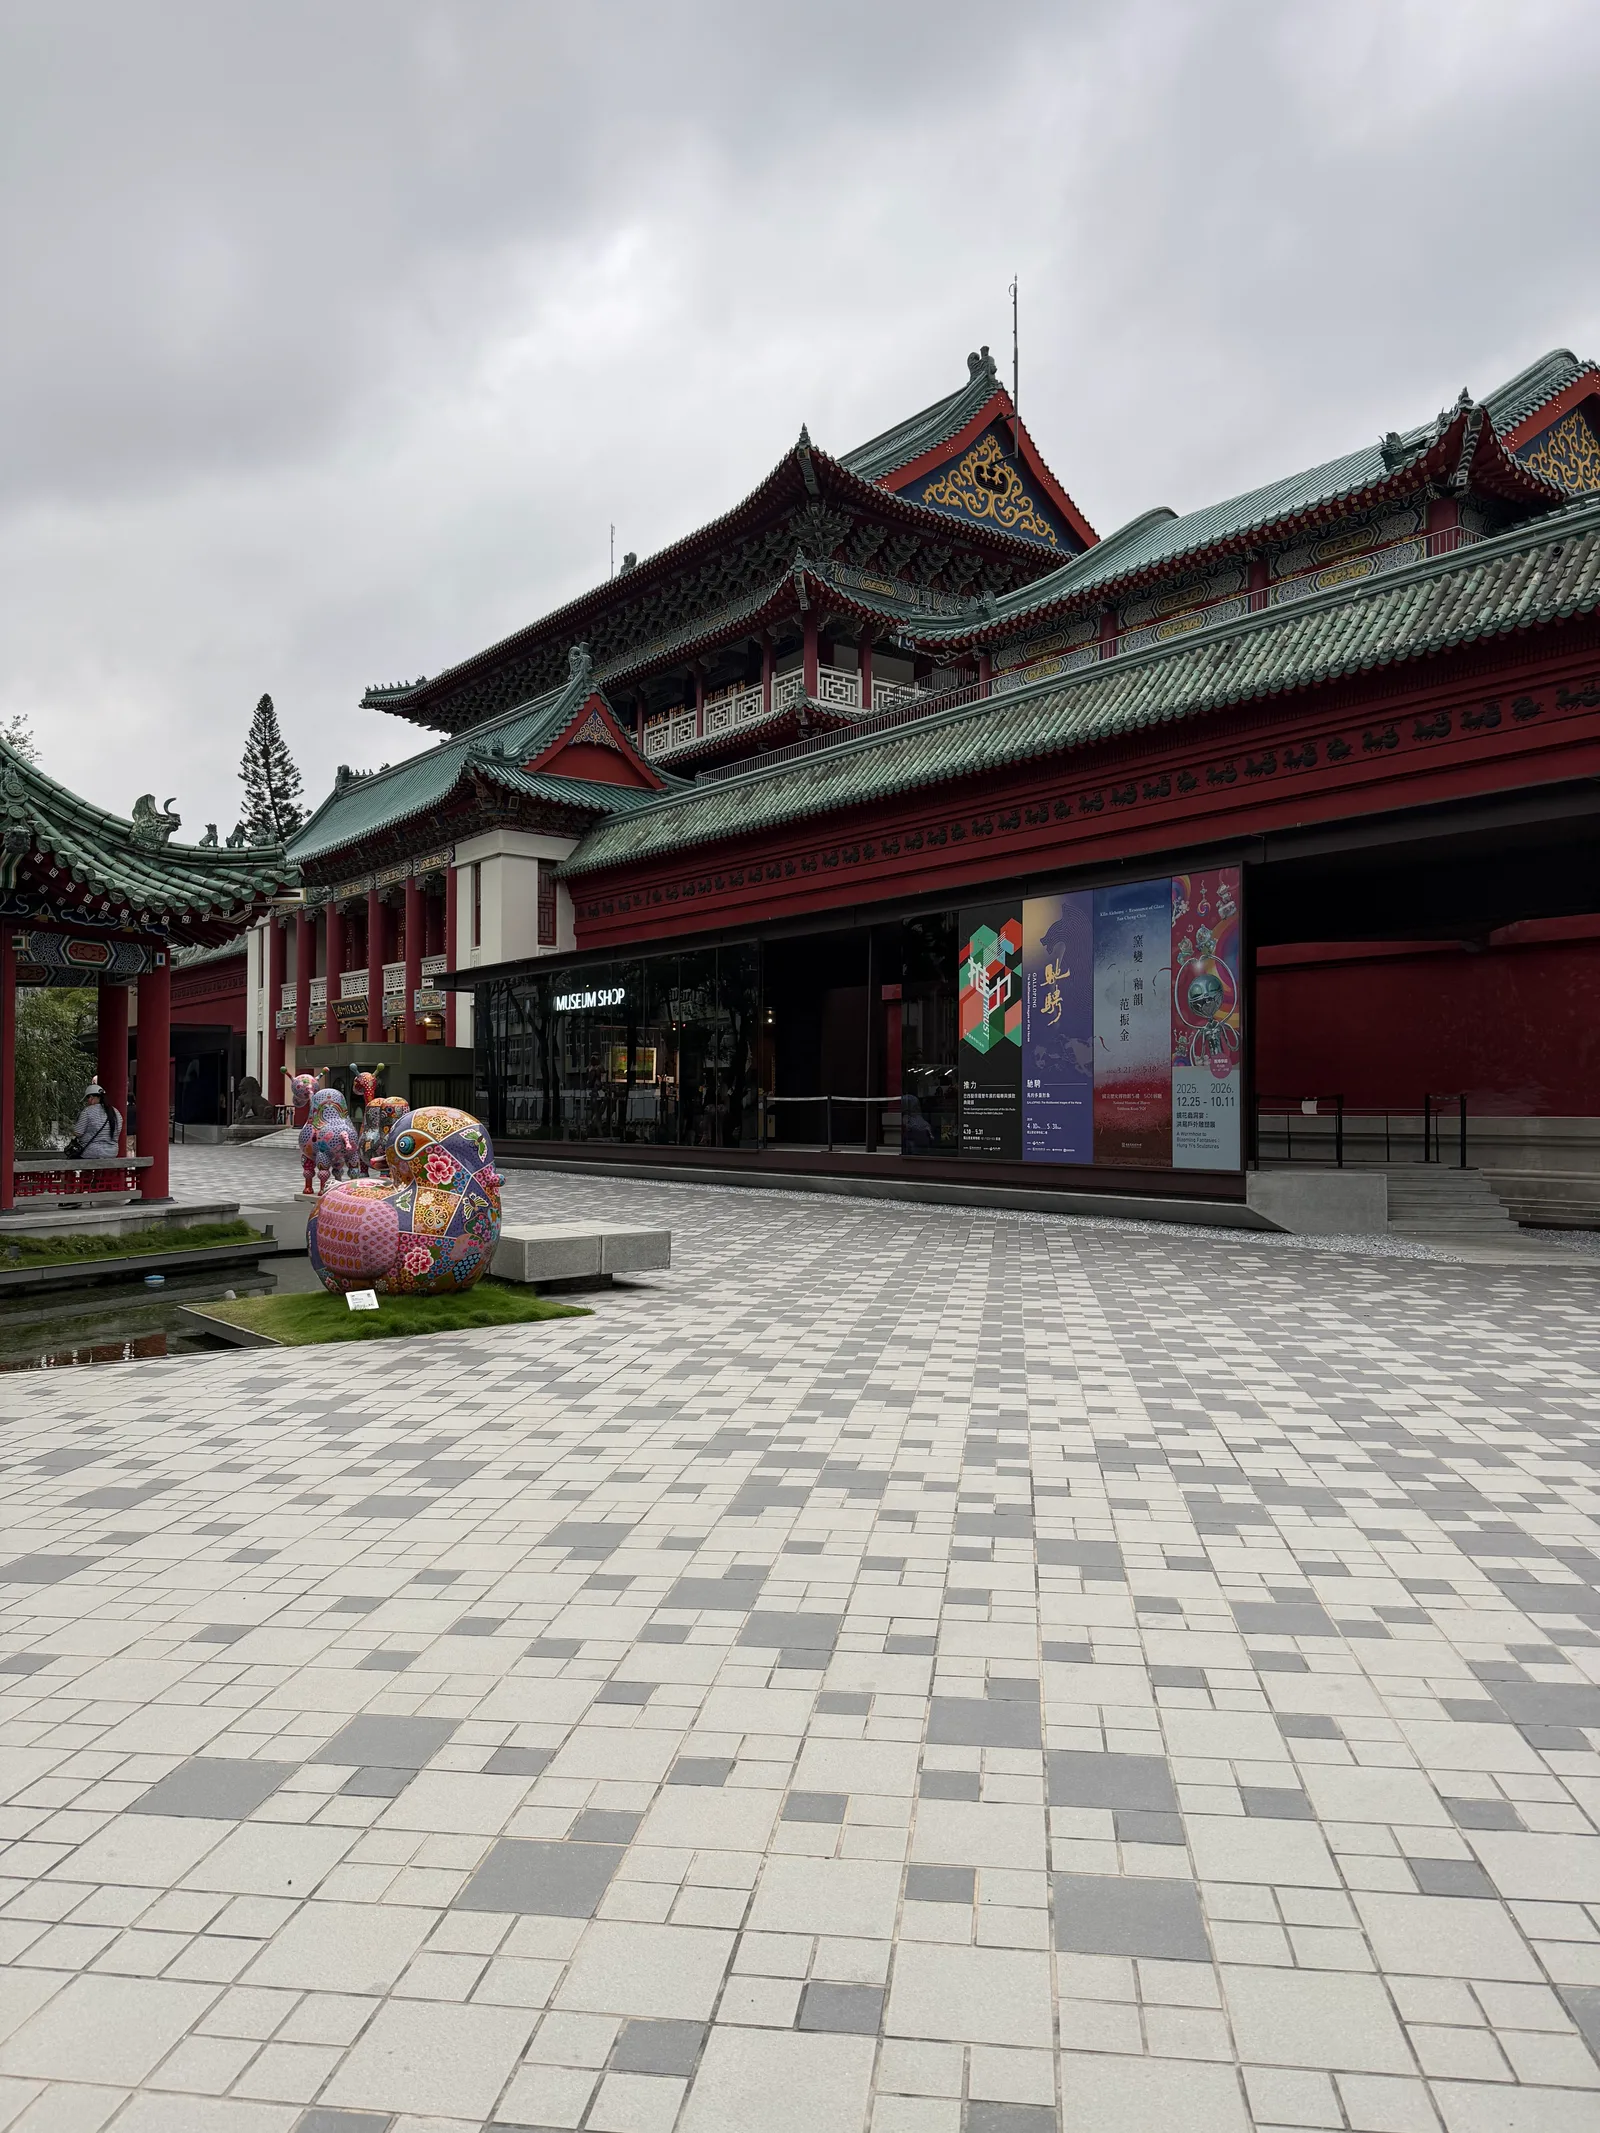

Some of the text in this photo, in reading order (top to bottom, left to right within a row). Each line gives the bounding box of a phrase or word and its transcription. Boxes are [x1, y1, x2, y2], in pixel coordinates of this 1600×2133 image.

[555, 988, 625, 1011] MUSEUM SHOP
[982, 997, 990, 1040] THRUST
[1120, 998, 1129, 1041] 范振金
[963, 1081, 977, 1089] 推力
[1027, 1079, 1041, 1088] 馳騁
[1176, 1083, 1234, 1094] 2025. 2026.
[1177, 1097, 1200, 1106] 12.25
[1211, 1097, 1234, 1106] 10.11
